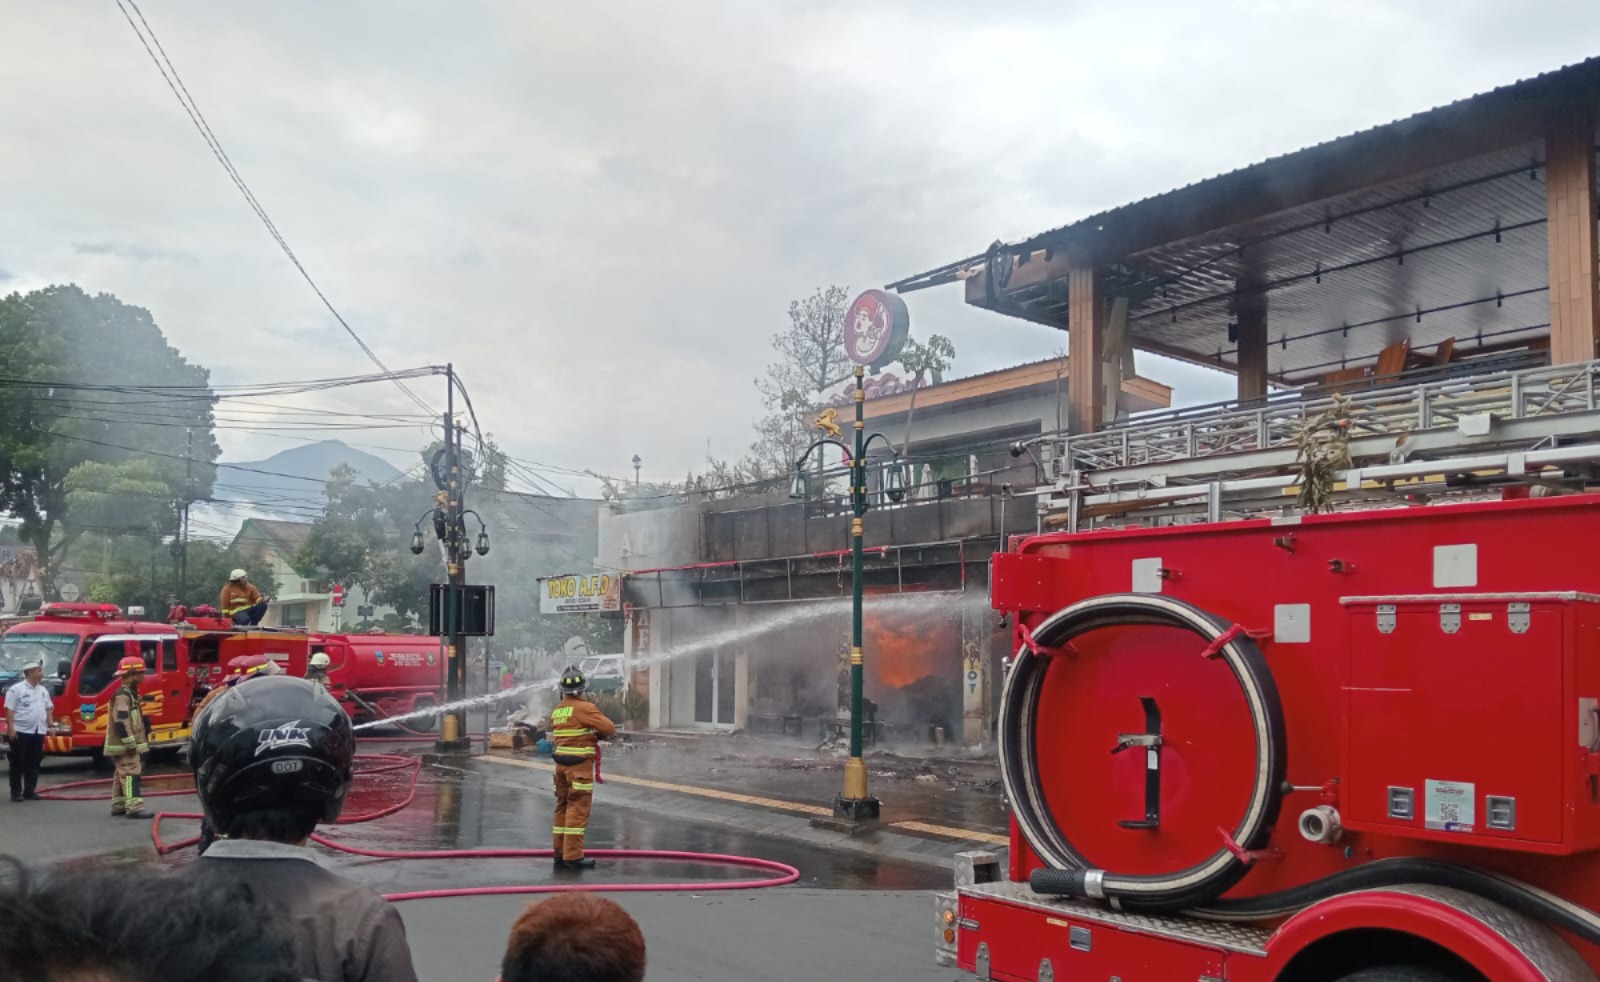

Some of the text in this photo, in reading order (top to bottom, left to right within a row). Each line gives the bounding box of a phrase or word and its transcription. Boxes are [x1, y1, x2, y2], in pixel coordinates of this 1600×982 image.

[547, 578, 576, 599] TOKO
[257, 724, 312, 746] INK
[275, 762, 298, 772] DOT
